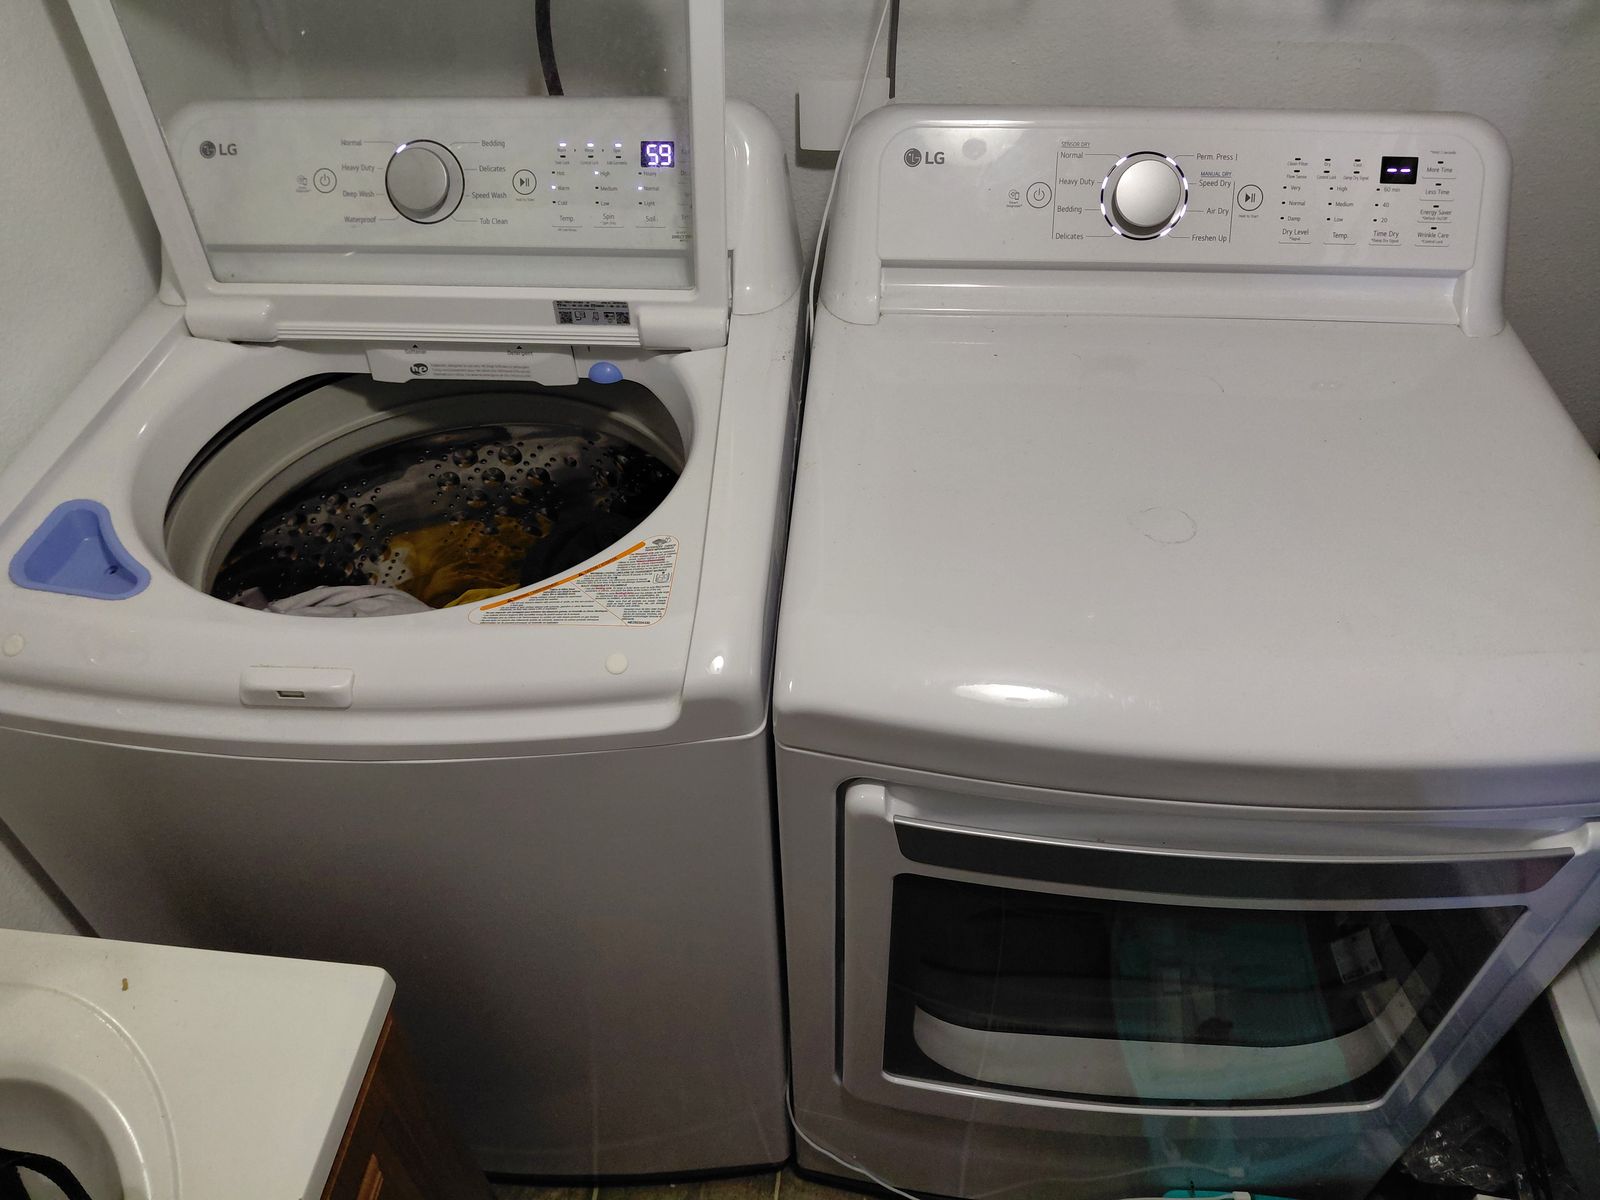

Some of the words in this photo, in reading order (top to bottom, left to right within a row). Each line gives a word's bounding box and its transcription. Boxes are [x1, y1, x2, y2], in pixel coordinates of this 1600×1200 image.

[481, 140, 506, 148] Bedding
[218, 144, 238, 156] LG
[646, 144, 672, 166] 59
[926, 152, 945, 165] LG
[342, 164, 359, 173] Heavy
[360, 164, 375, 172] Duty
[1219, 180, 1231, 188] Dry
[342, 190, 358, 199] Deep
[1057, 206, 1082, 214] Bedding
[1218, 208, 1229, 216] Dry
[344, 216, 376, 224] Waterproof
[1282, 228, 1293, 236] Dry
[1388, 231, 1400, 239] Dry
[1218, 235, 1228, 243] Up
